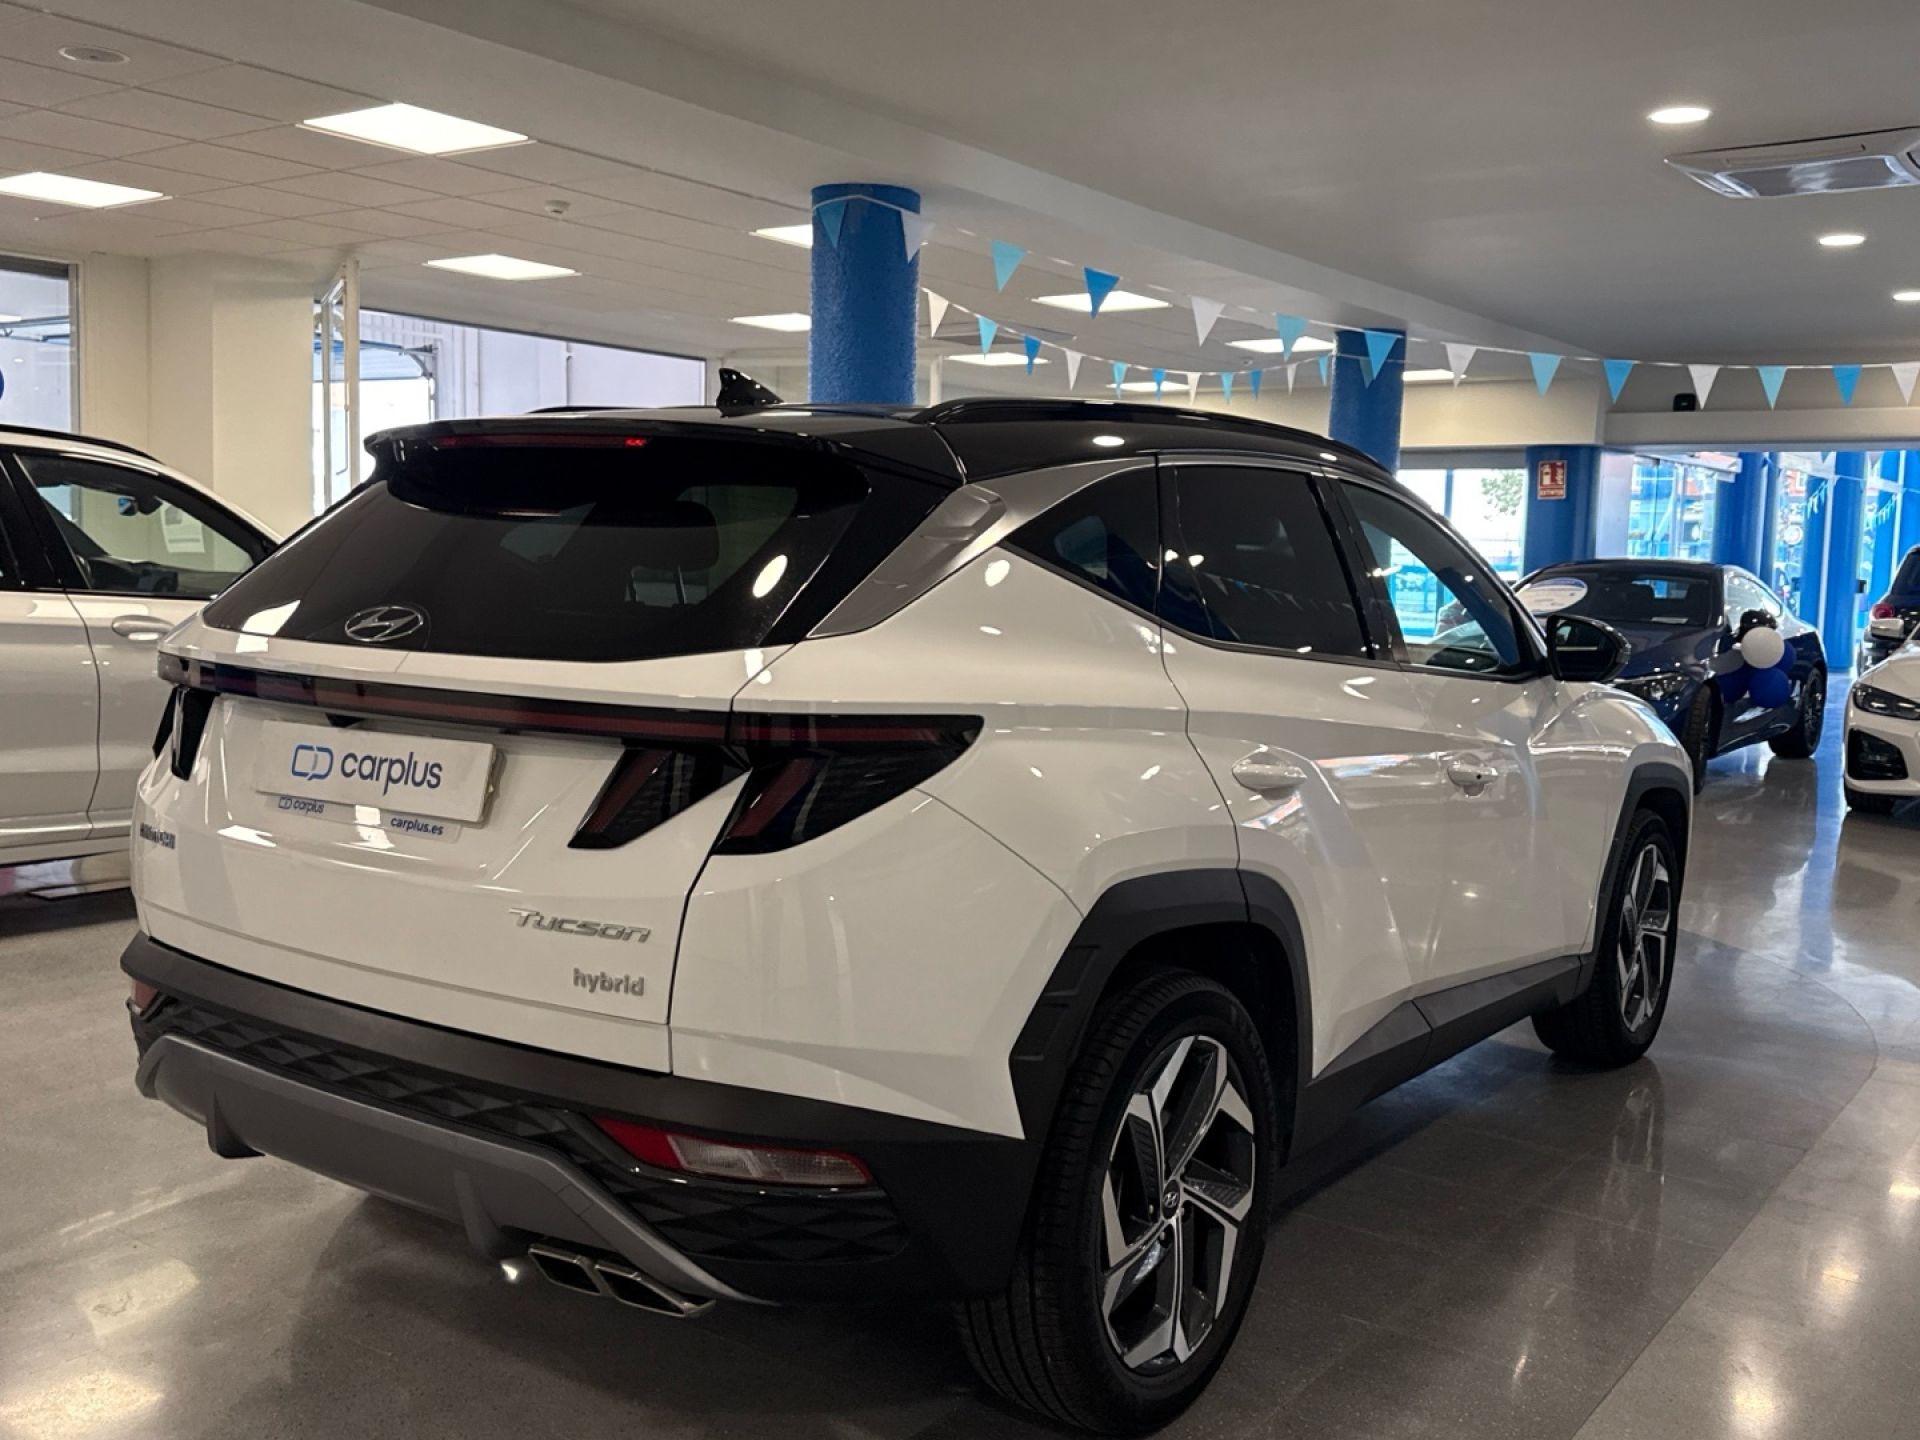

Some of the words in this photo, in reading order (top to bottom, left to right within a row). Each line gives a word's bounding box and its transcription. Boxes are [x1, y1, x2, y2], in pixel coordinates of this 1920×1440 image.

[341, 752, 443, 796] carplus
[293, 800, 325, 815] carplus
[390, 816, 443, 836] carplus.es
[573, 967, 645, 997] hybrid
